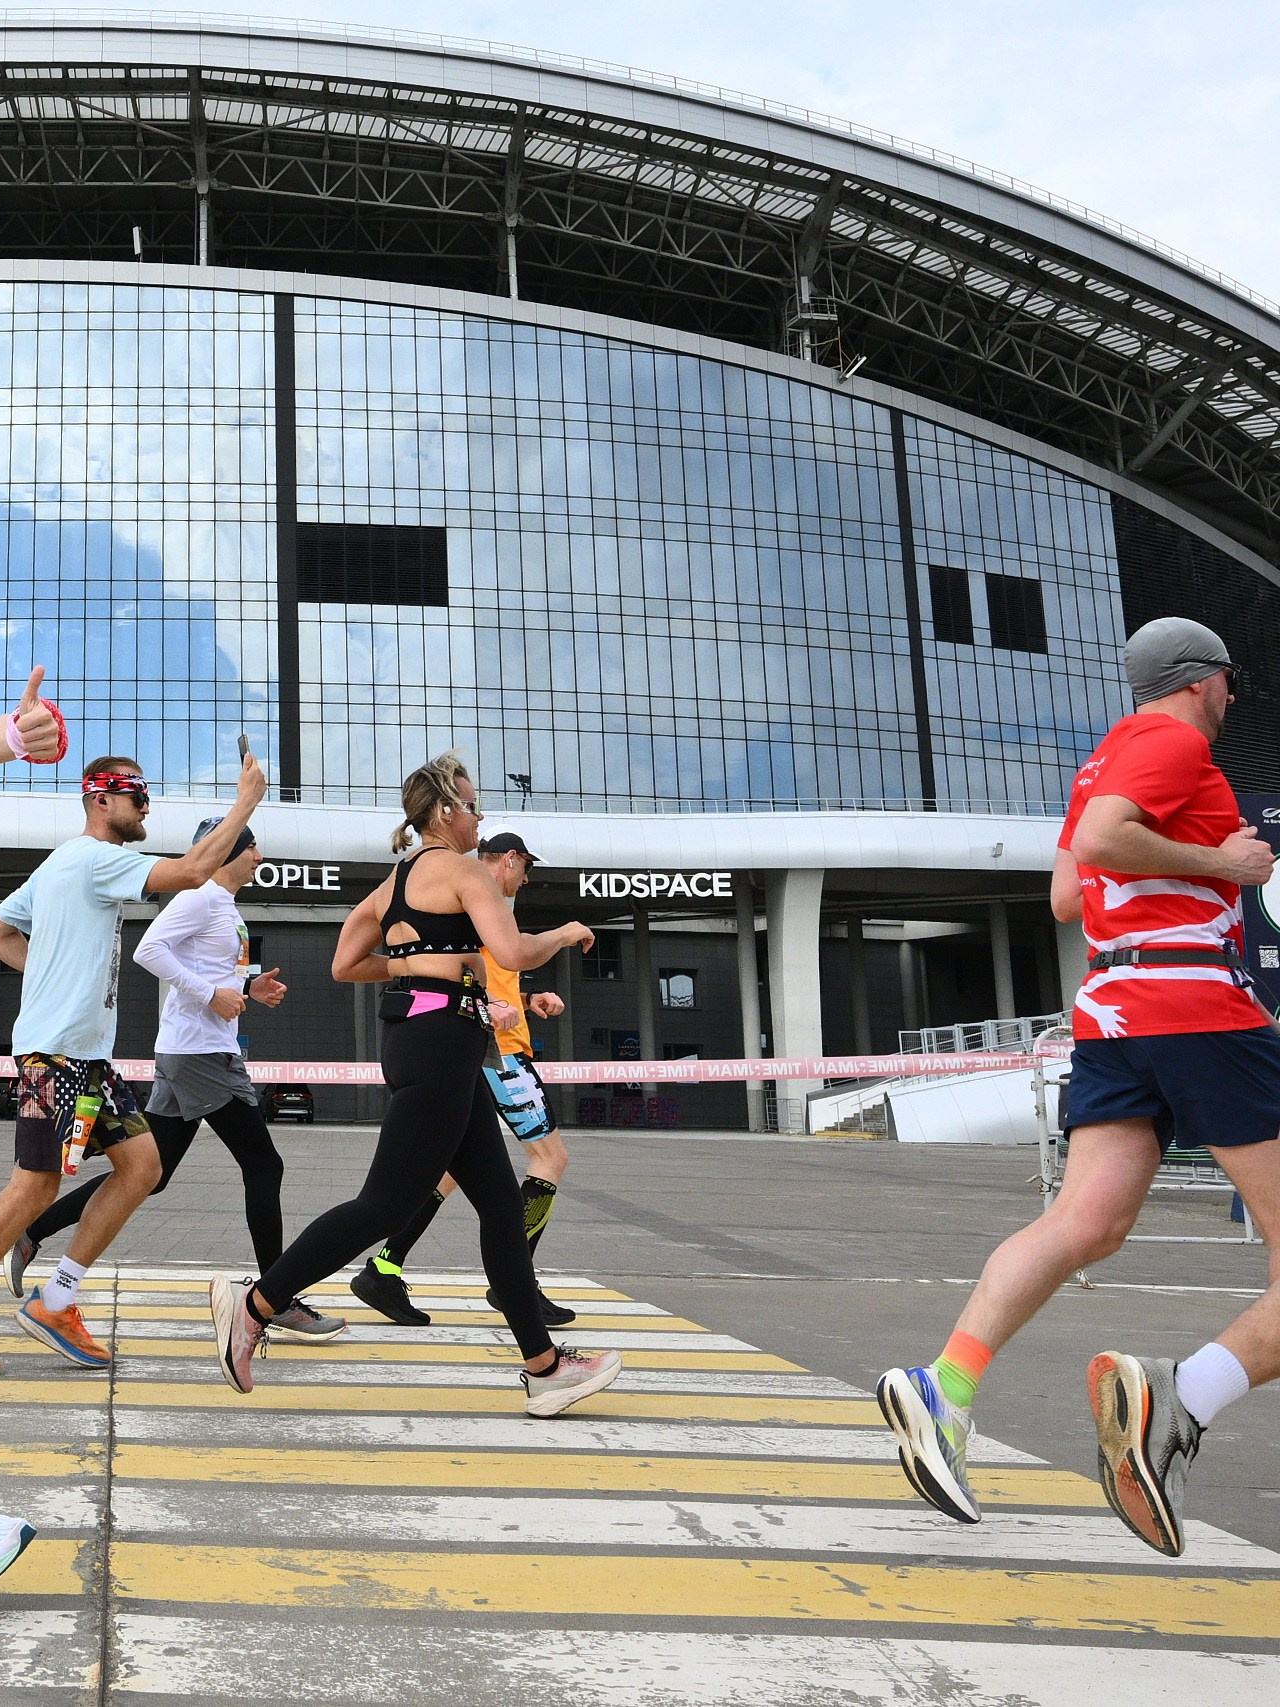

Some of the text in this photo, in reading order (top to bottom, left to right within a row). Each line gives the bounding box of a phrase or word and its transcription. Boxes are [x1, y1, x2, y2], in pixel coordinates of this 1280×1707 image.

[243, 862, 342, 891] OPLE
[579, 872, 733, 898] KIDSPACE
[75, 1124, 82, 1134] D
